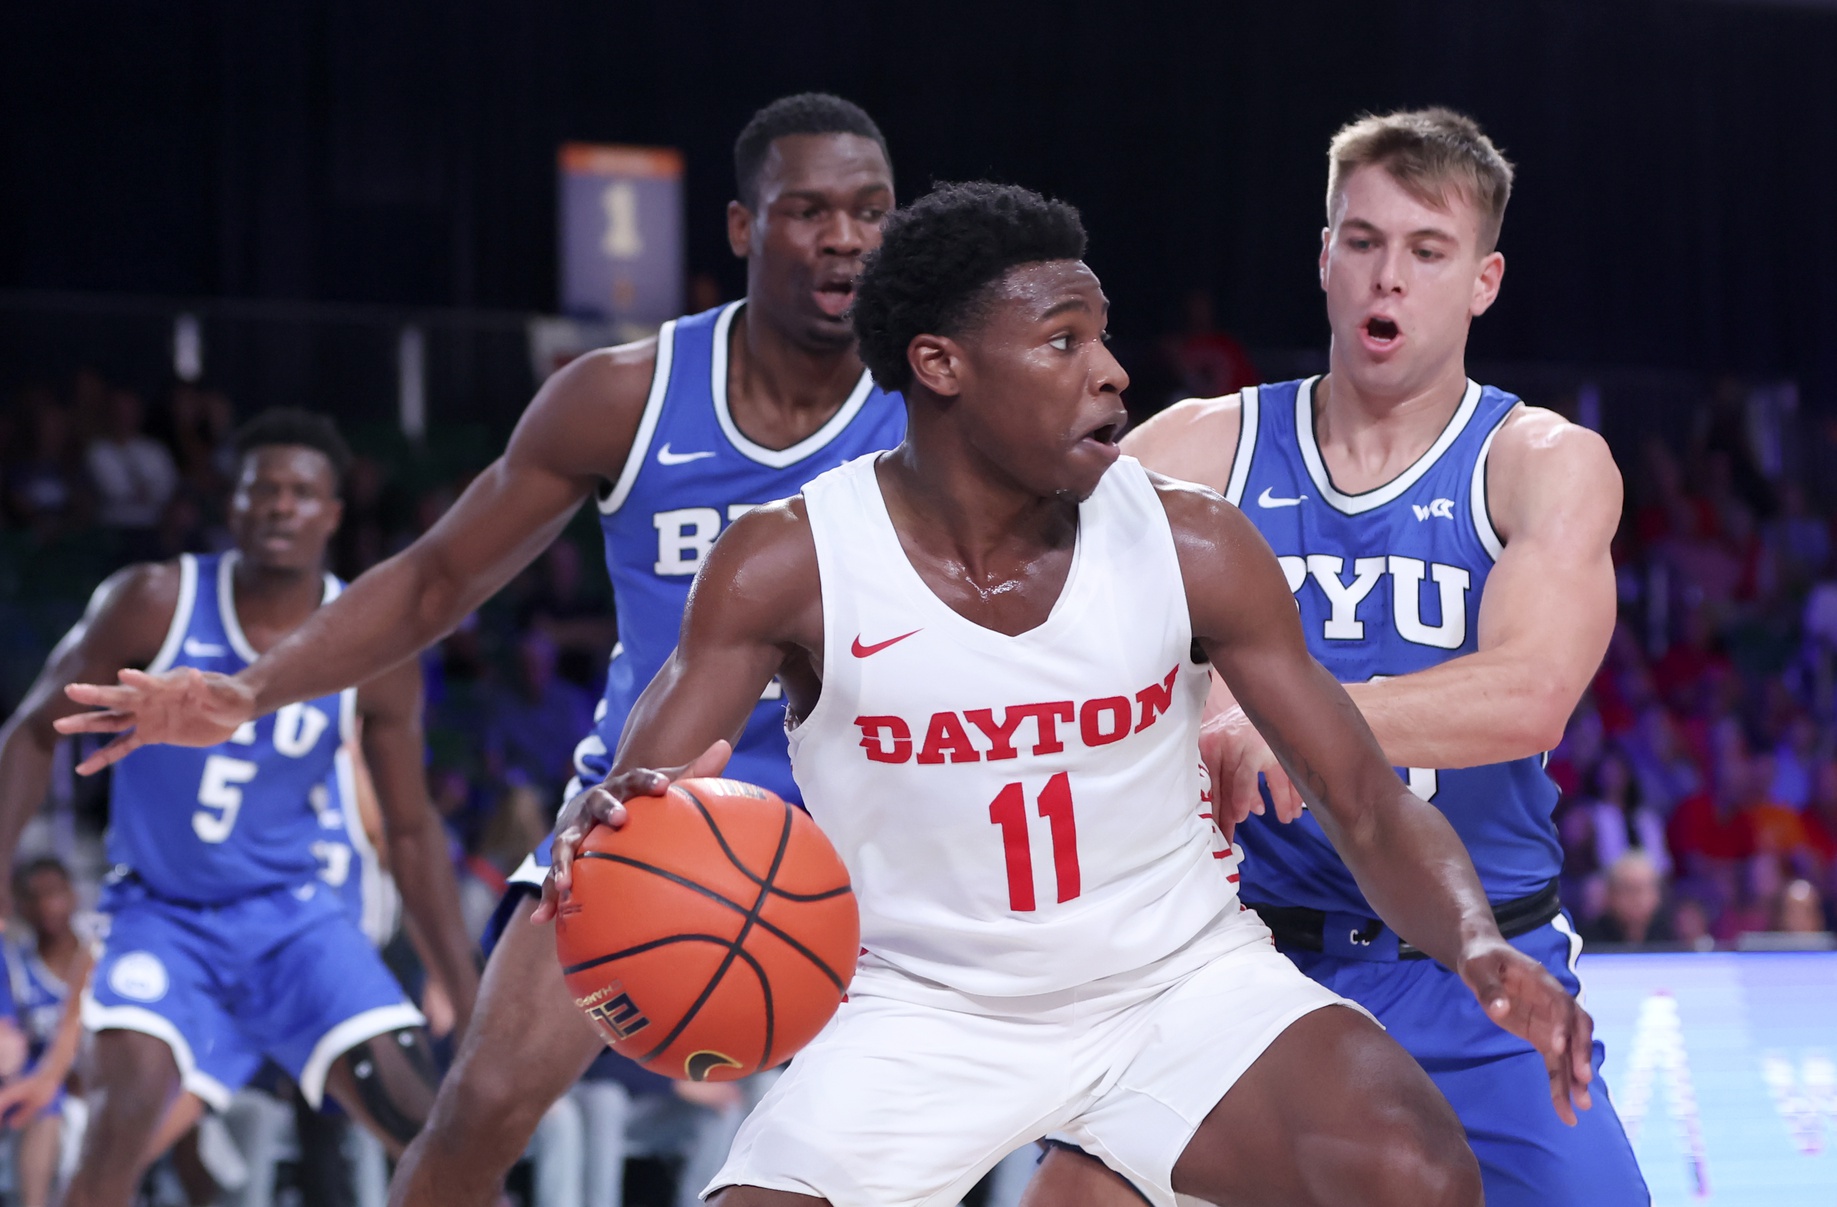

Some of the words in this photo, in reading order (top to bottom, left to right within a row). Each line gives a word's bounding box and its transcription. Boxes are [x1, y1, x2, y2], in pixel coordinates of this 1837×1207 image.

[653, 504, 763, 576] B
[853, 663, 1180, 764] DAYTON
[191, 754, 258, 844] 5
[988, 770, 1081, 912] 11
